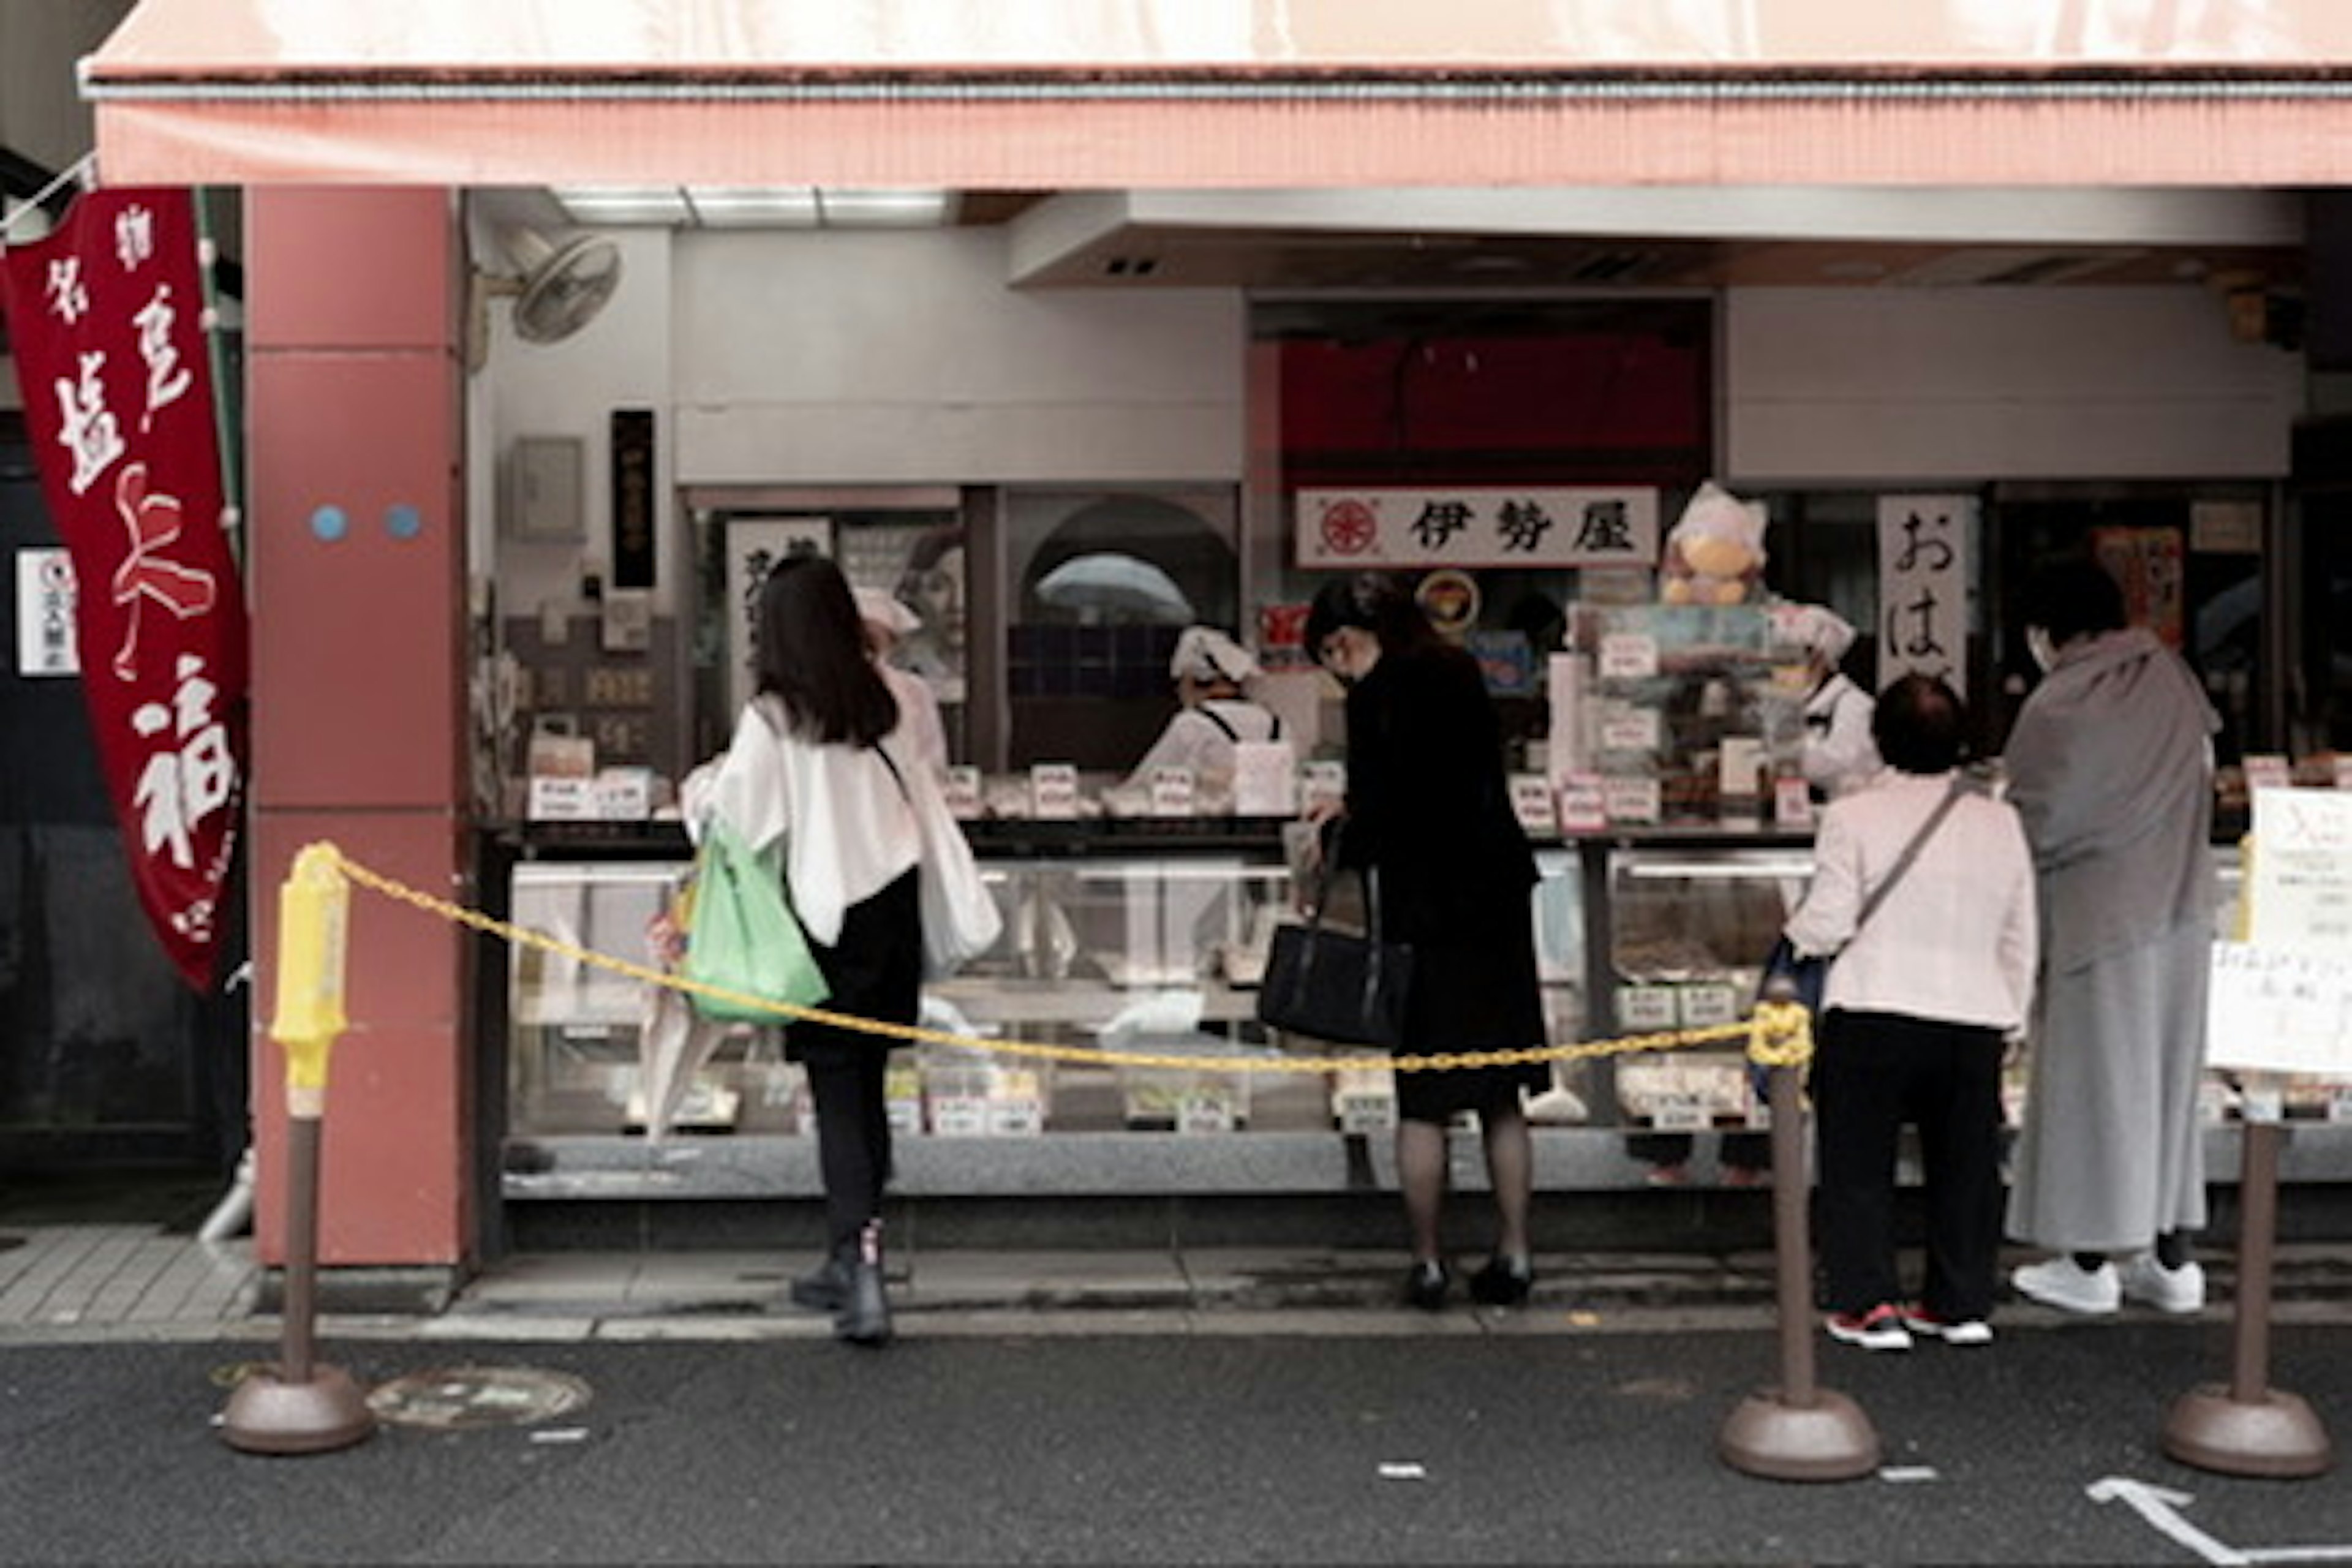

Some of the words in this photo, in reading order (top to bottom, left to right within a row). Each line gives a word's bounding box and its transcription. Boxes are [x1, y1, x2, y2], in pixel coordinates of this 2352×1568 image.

[1410, 499, 1635, 552] 伊勢屋
[1887, 510, 1953, 680] おは
